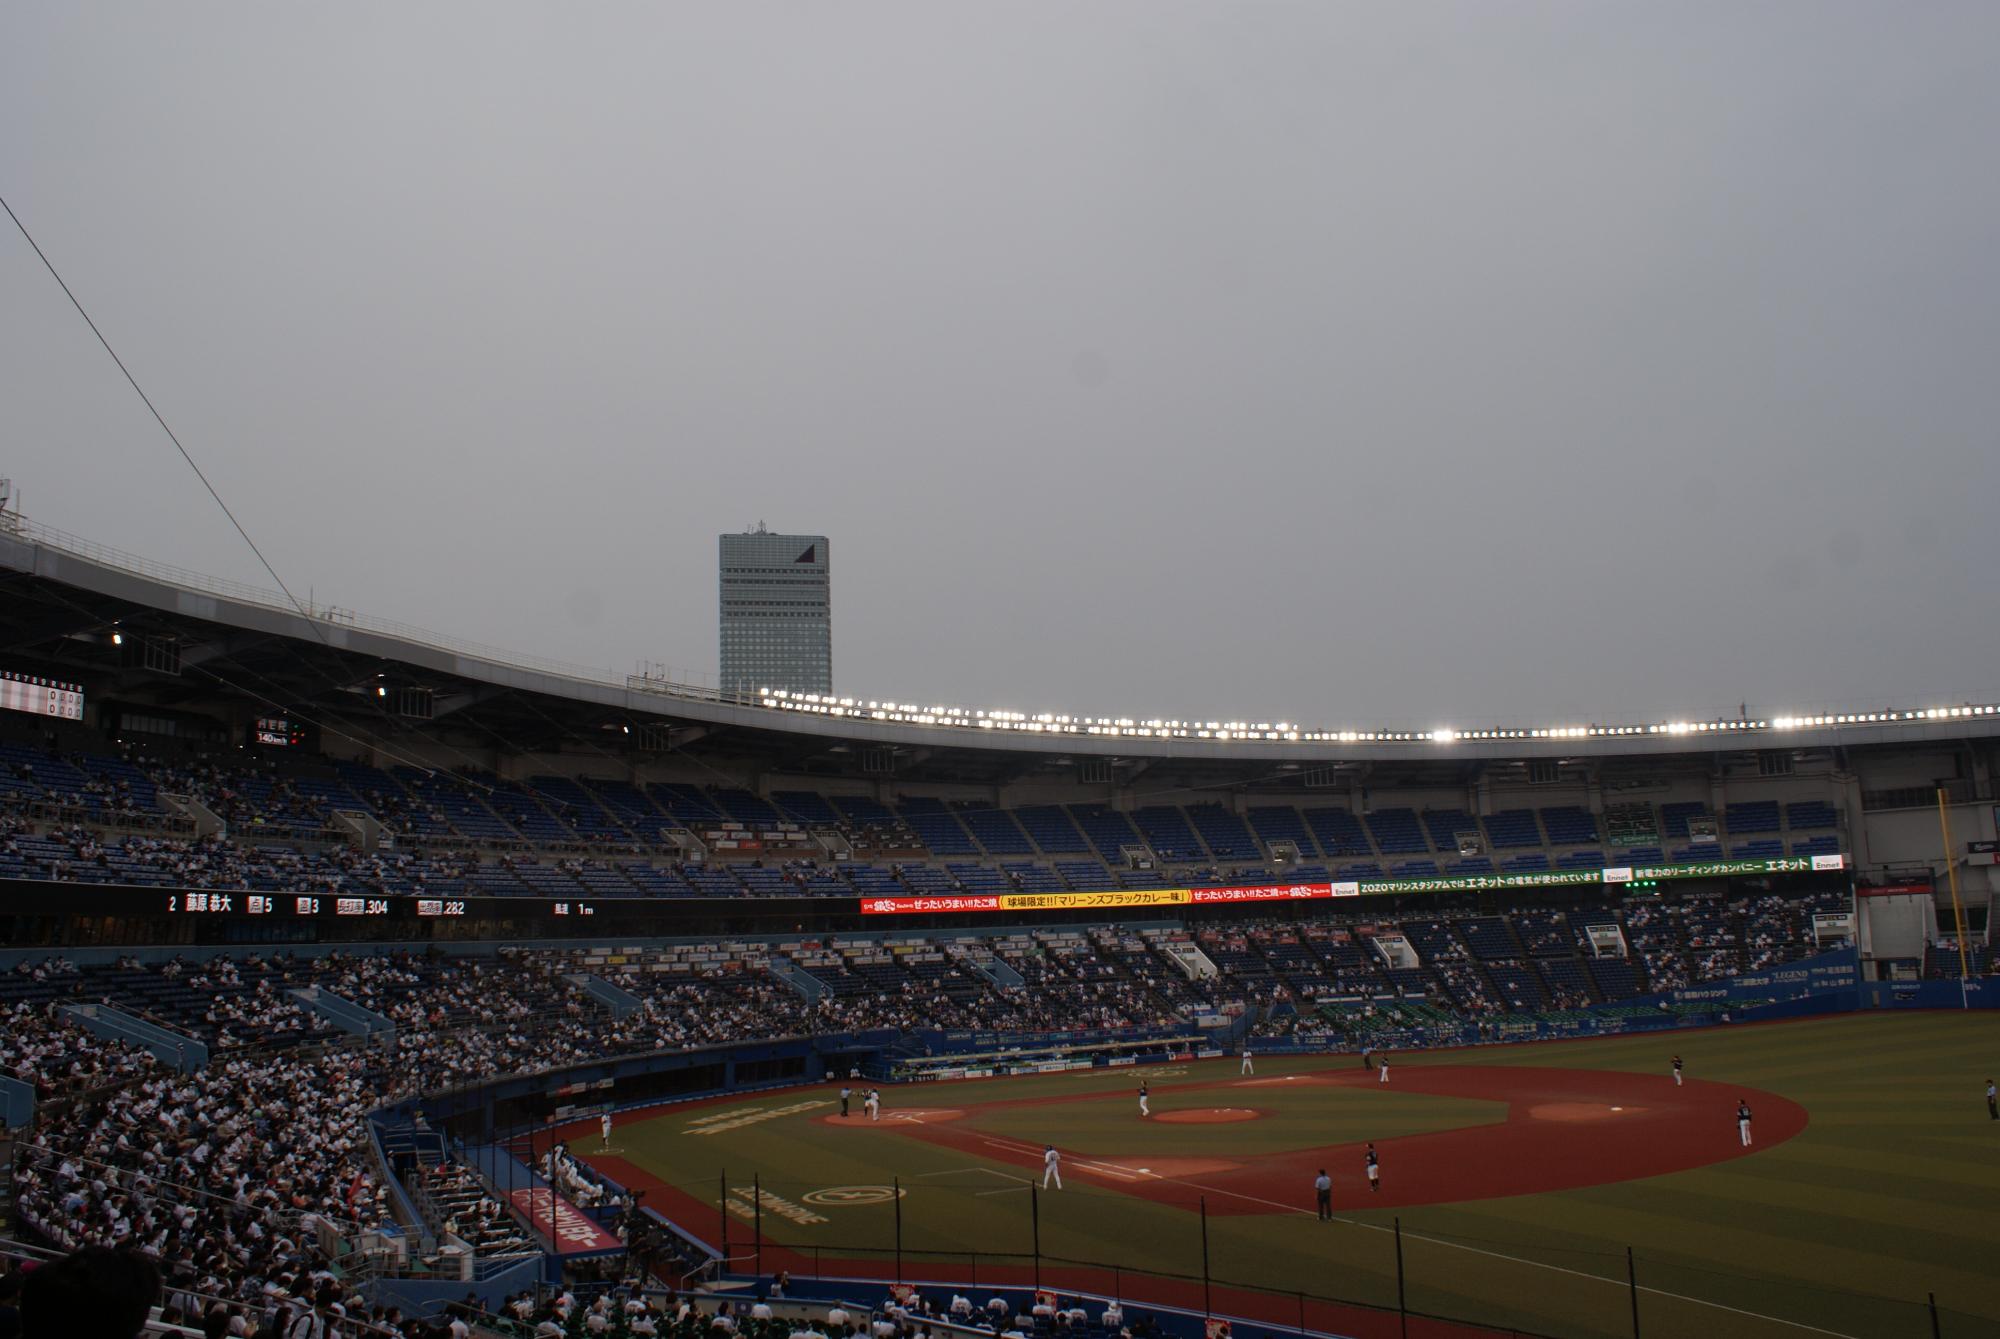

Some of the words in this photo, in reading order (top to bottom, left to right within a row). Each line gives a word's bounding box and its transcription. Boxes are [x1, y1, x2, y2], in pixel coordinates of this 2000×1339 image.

[1765, 858, 1809, 871] エネット
[169, 896, 176, 911] 2
[265, 898, 272, 912] 5
[312, 899, 319, 913] 3
[365, 901, 388, 914] .304
[443, 902, 465, 915] .282
